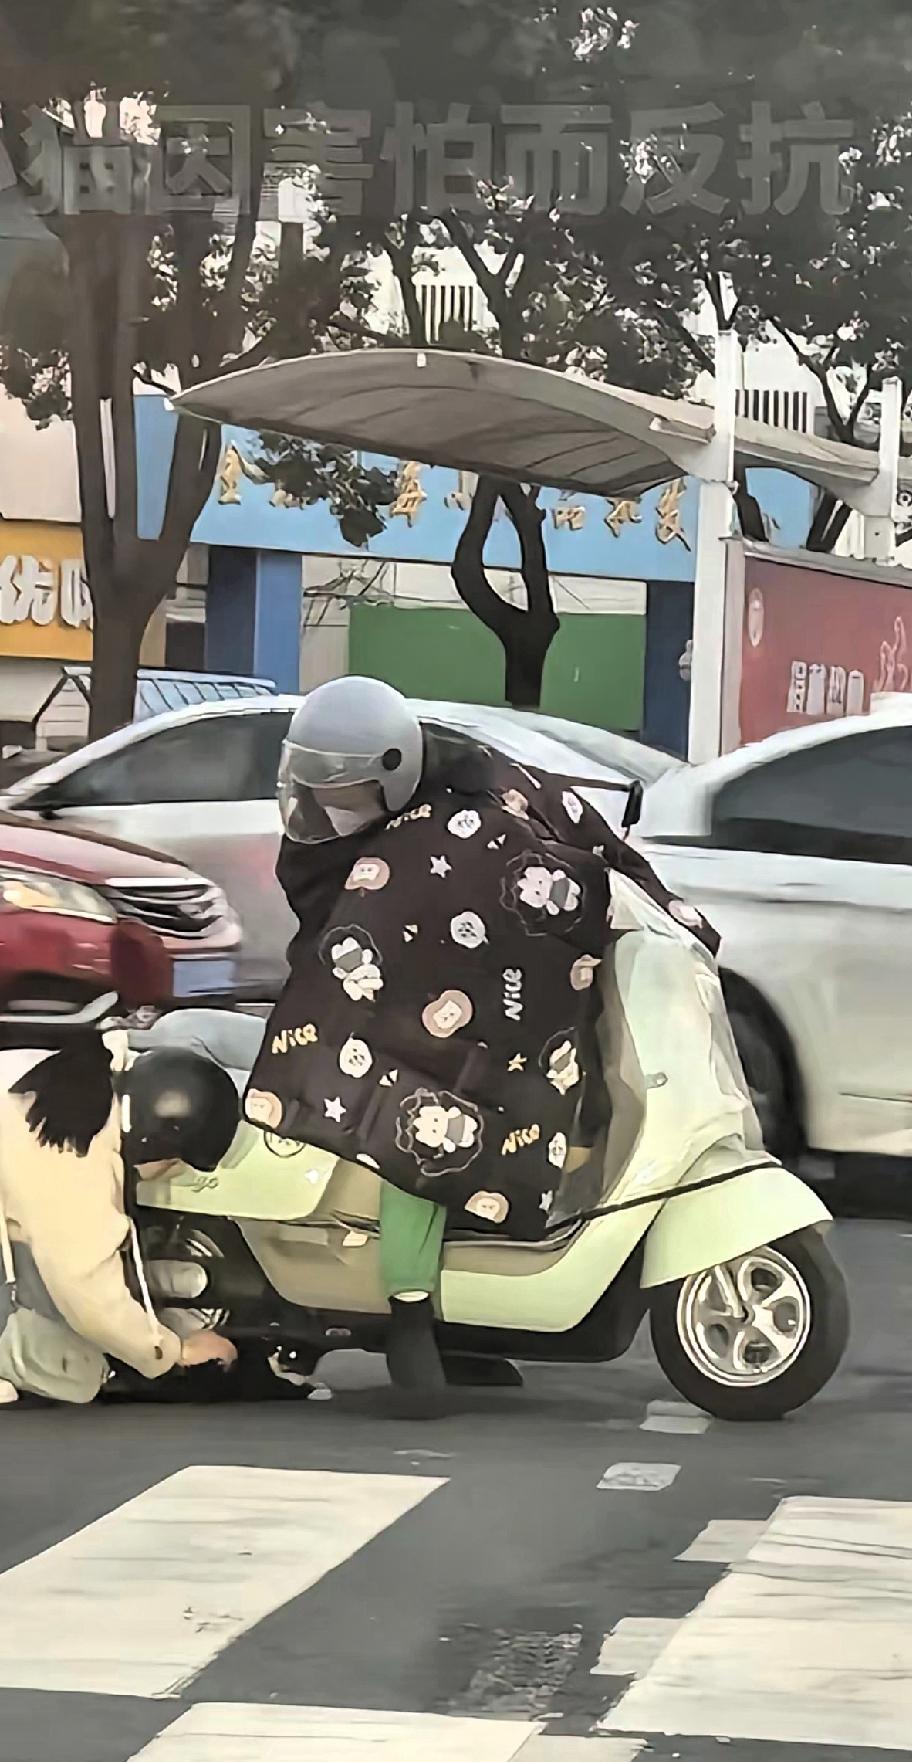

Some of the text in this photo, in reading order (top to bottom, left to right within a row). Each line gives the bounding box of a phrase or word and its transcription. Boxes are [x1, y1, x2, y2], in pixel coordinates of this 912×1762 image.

[502, 968, 523, 1021] Nice
[271, 1022, 319, 1055] Nice
[501, 1123, 541, 1156] Nice
